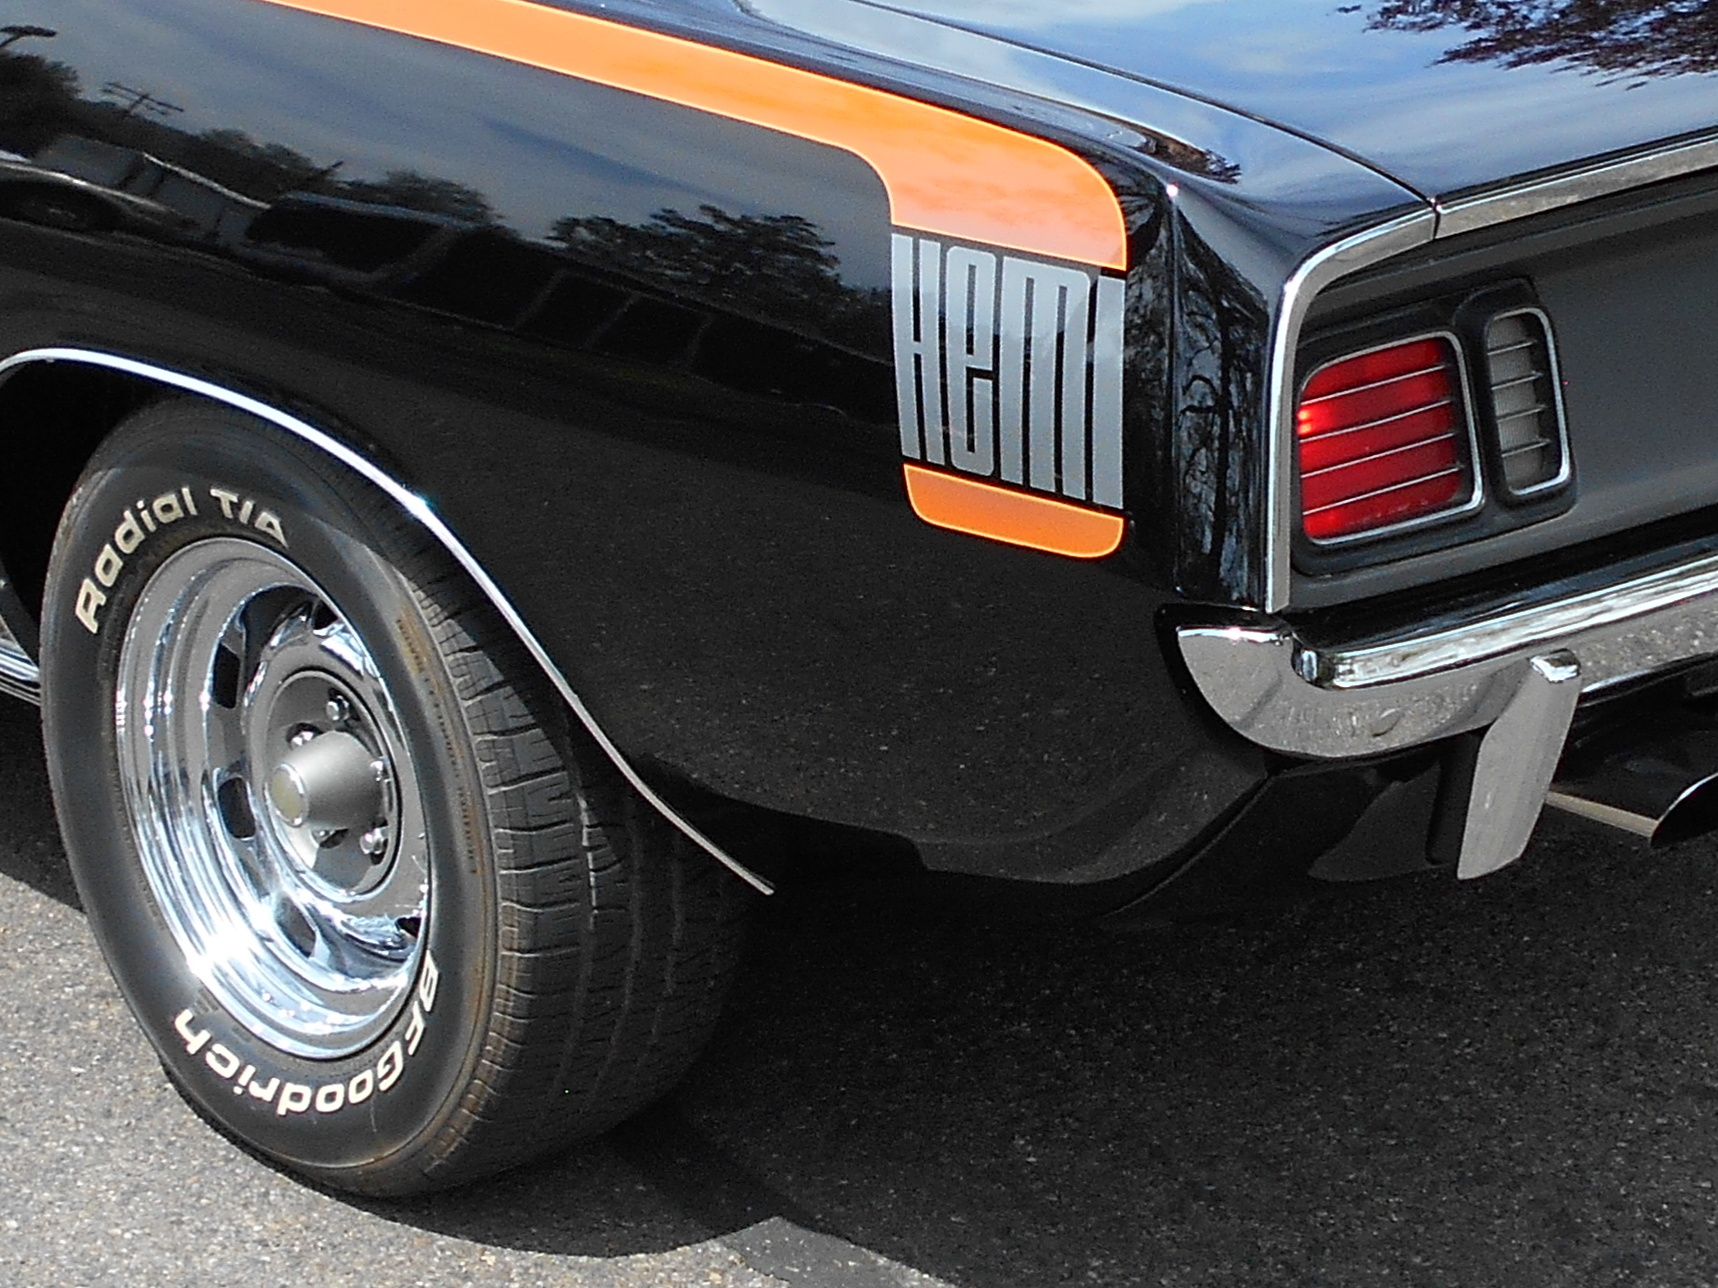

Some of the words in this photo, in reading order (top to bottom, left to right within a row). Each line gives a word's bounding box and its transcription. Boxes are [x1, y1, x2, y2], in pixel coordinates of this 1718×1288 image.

[75, 486, 198, 634] Radial
[210, 488, 289, 549] T/A
[174, 950, 439, 1116] BFGoodrich
